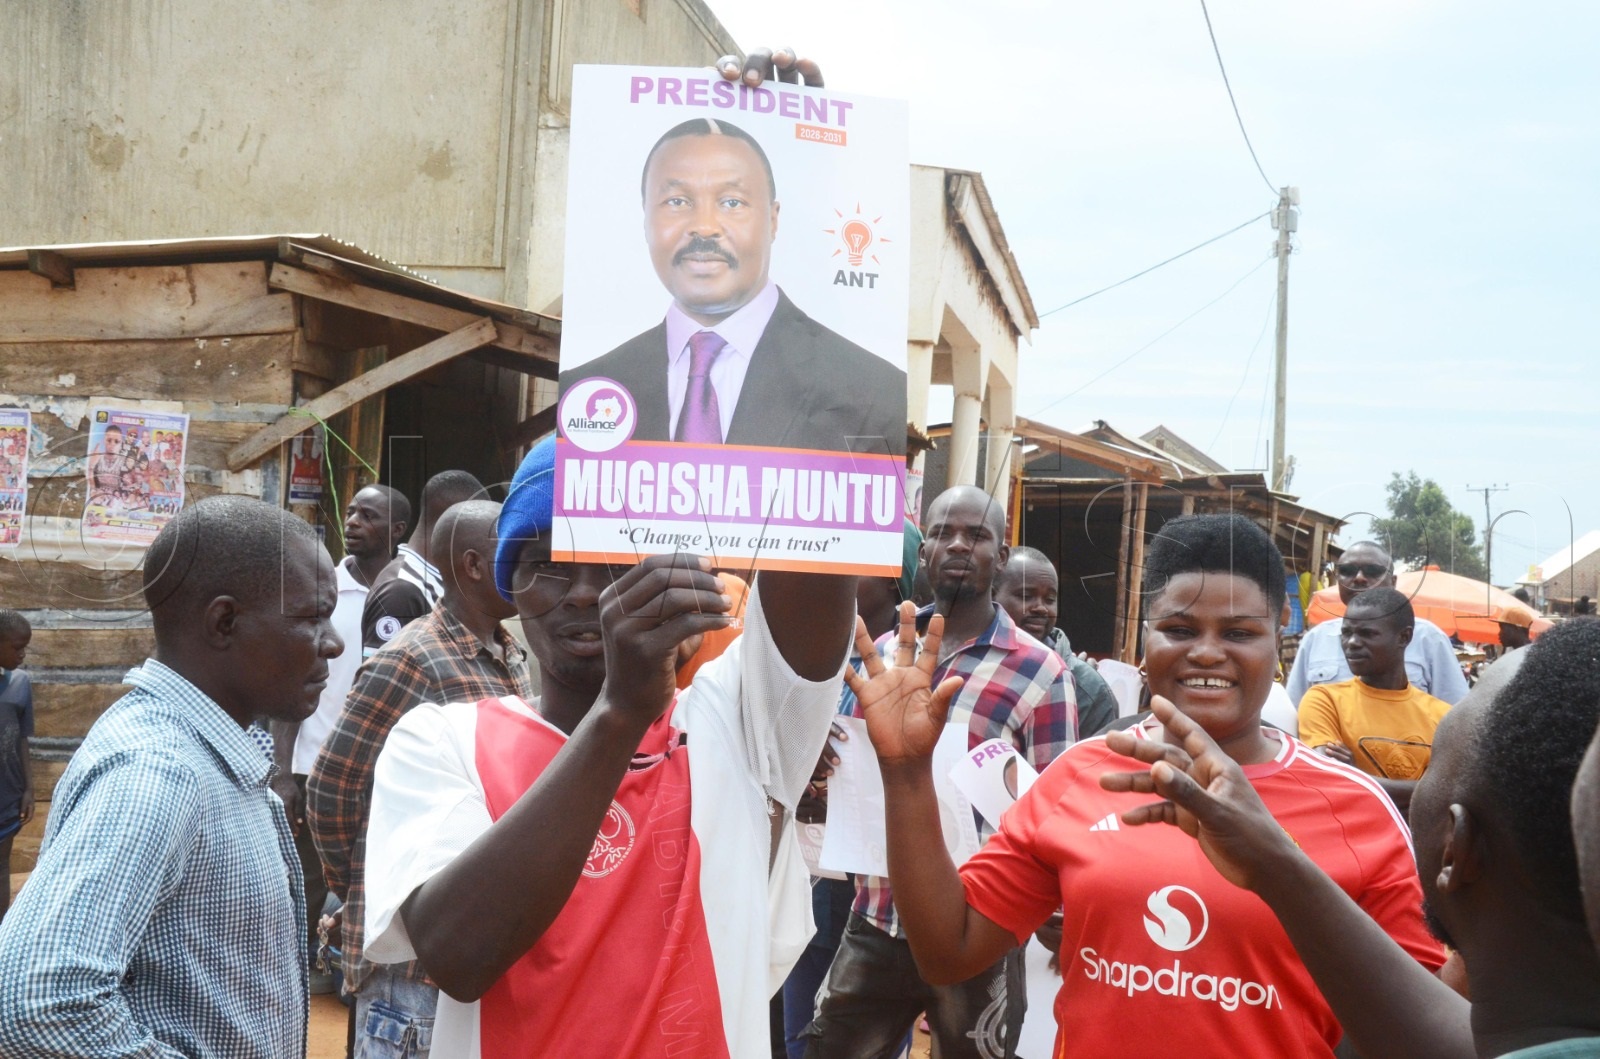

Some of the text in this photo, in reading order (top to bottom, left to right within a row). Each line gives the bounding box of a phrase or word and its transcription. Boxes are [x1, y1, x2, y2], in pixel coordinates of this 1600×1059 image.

[630, 76, 853, 126] PRESIDENT
[800, 128, 842, 143] 2026-2031
[833, 270, 879, 289] ANT
[567, 417, 616, 430] Alliance
[563, 458, 896, 526] MUGISHA MUNTU
[619, 527, 841, 554] “Change you can trust”
[1080, 948, 1282, 1009] Snapdragon
